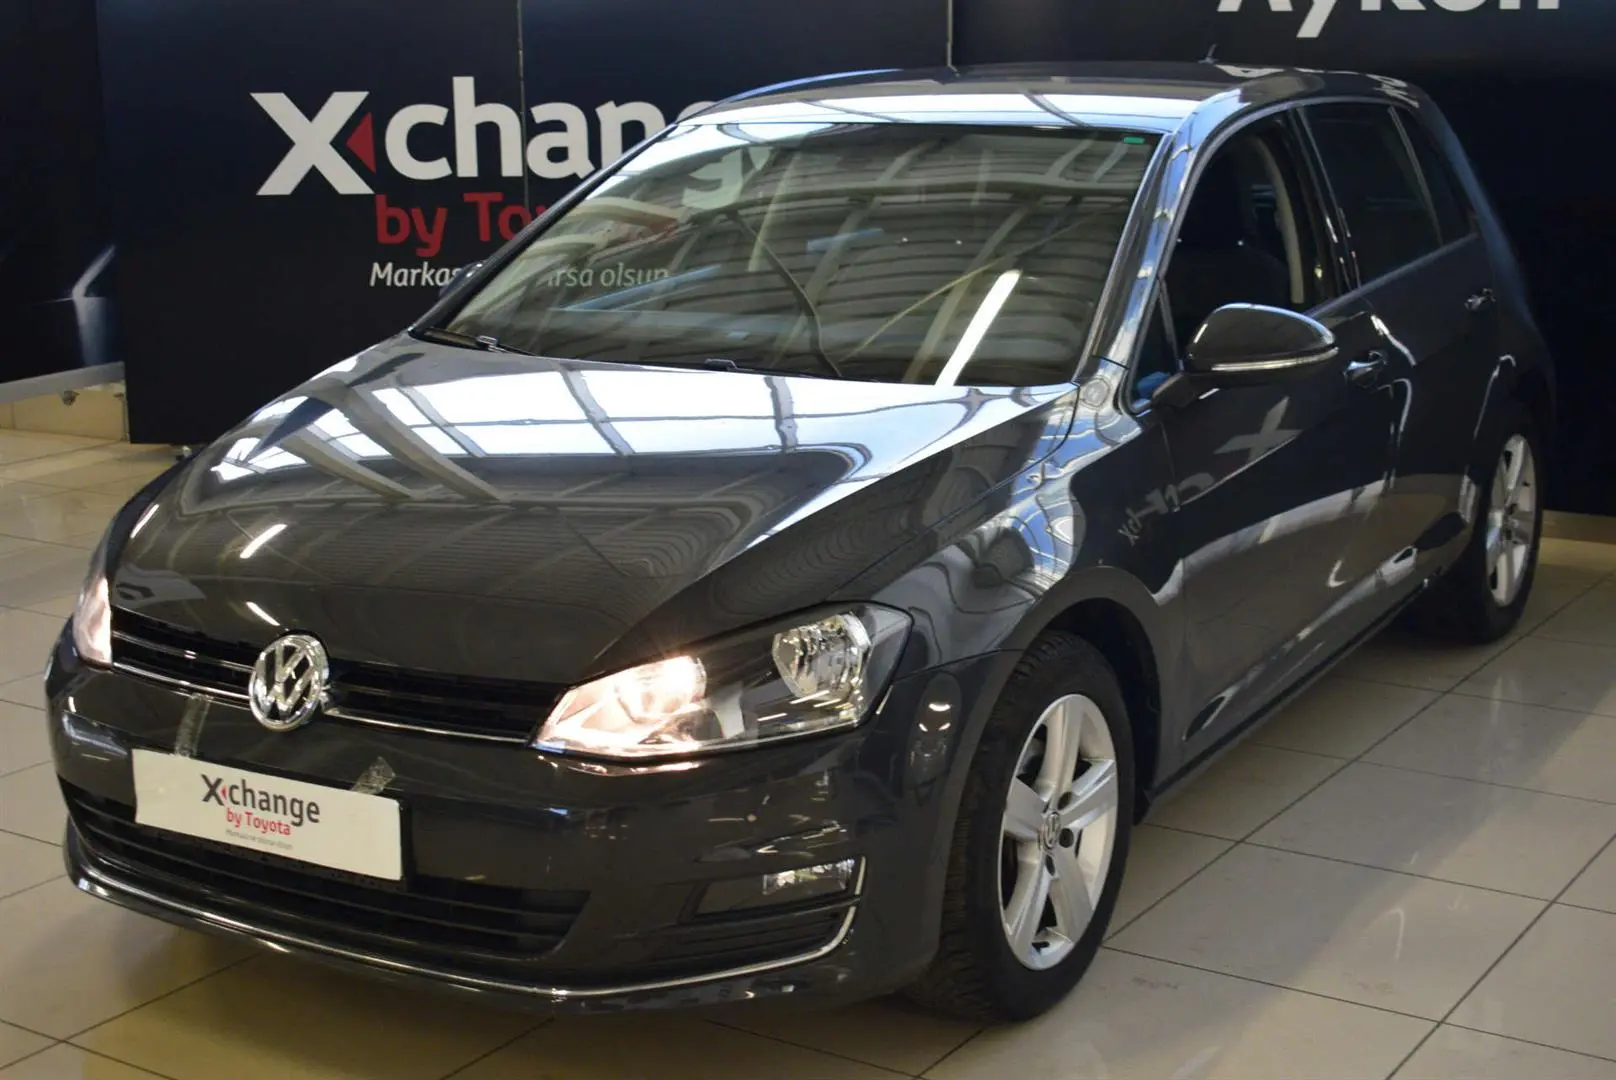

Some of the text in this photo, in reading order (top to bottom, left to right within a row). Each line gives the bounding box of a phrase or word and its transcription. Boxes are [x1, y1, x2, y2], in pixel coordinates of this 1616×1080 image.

[375, 194, 447, 257] by
[201, 774, 320, 826] Xchange
[226, 808, 291, 836] by Toyota
